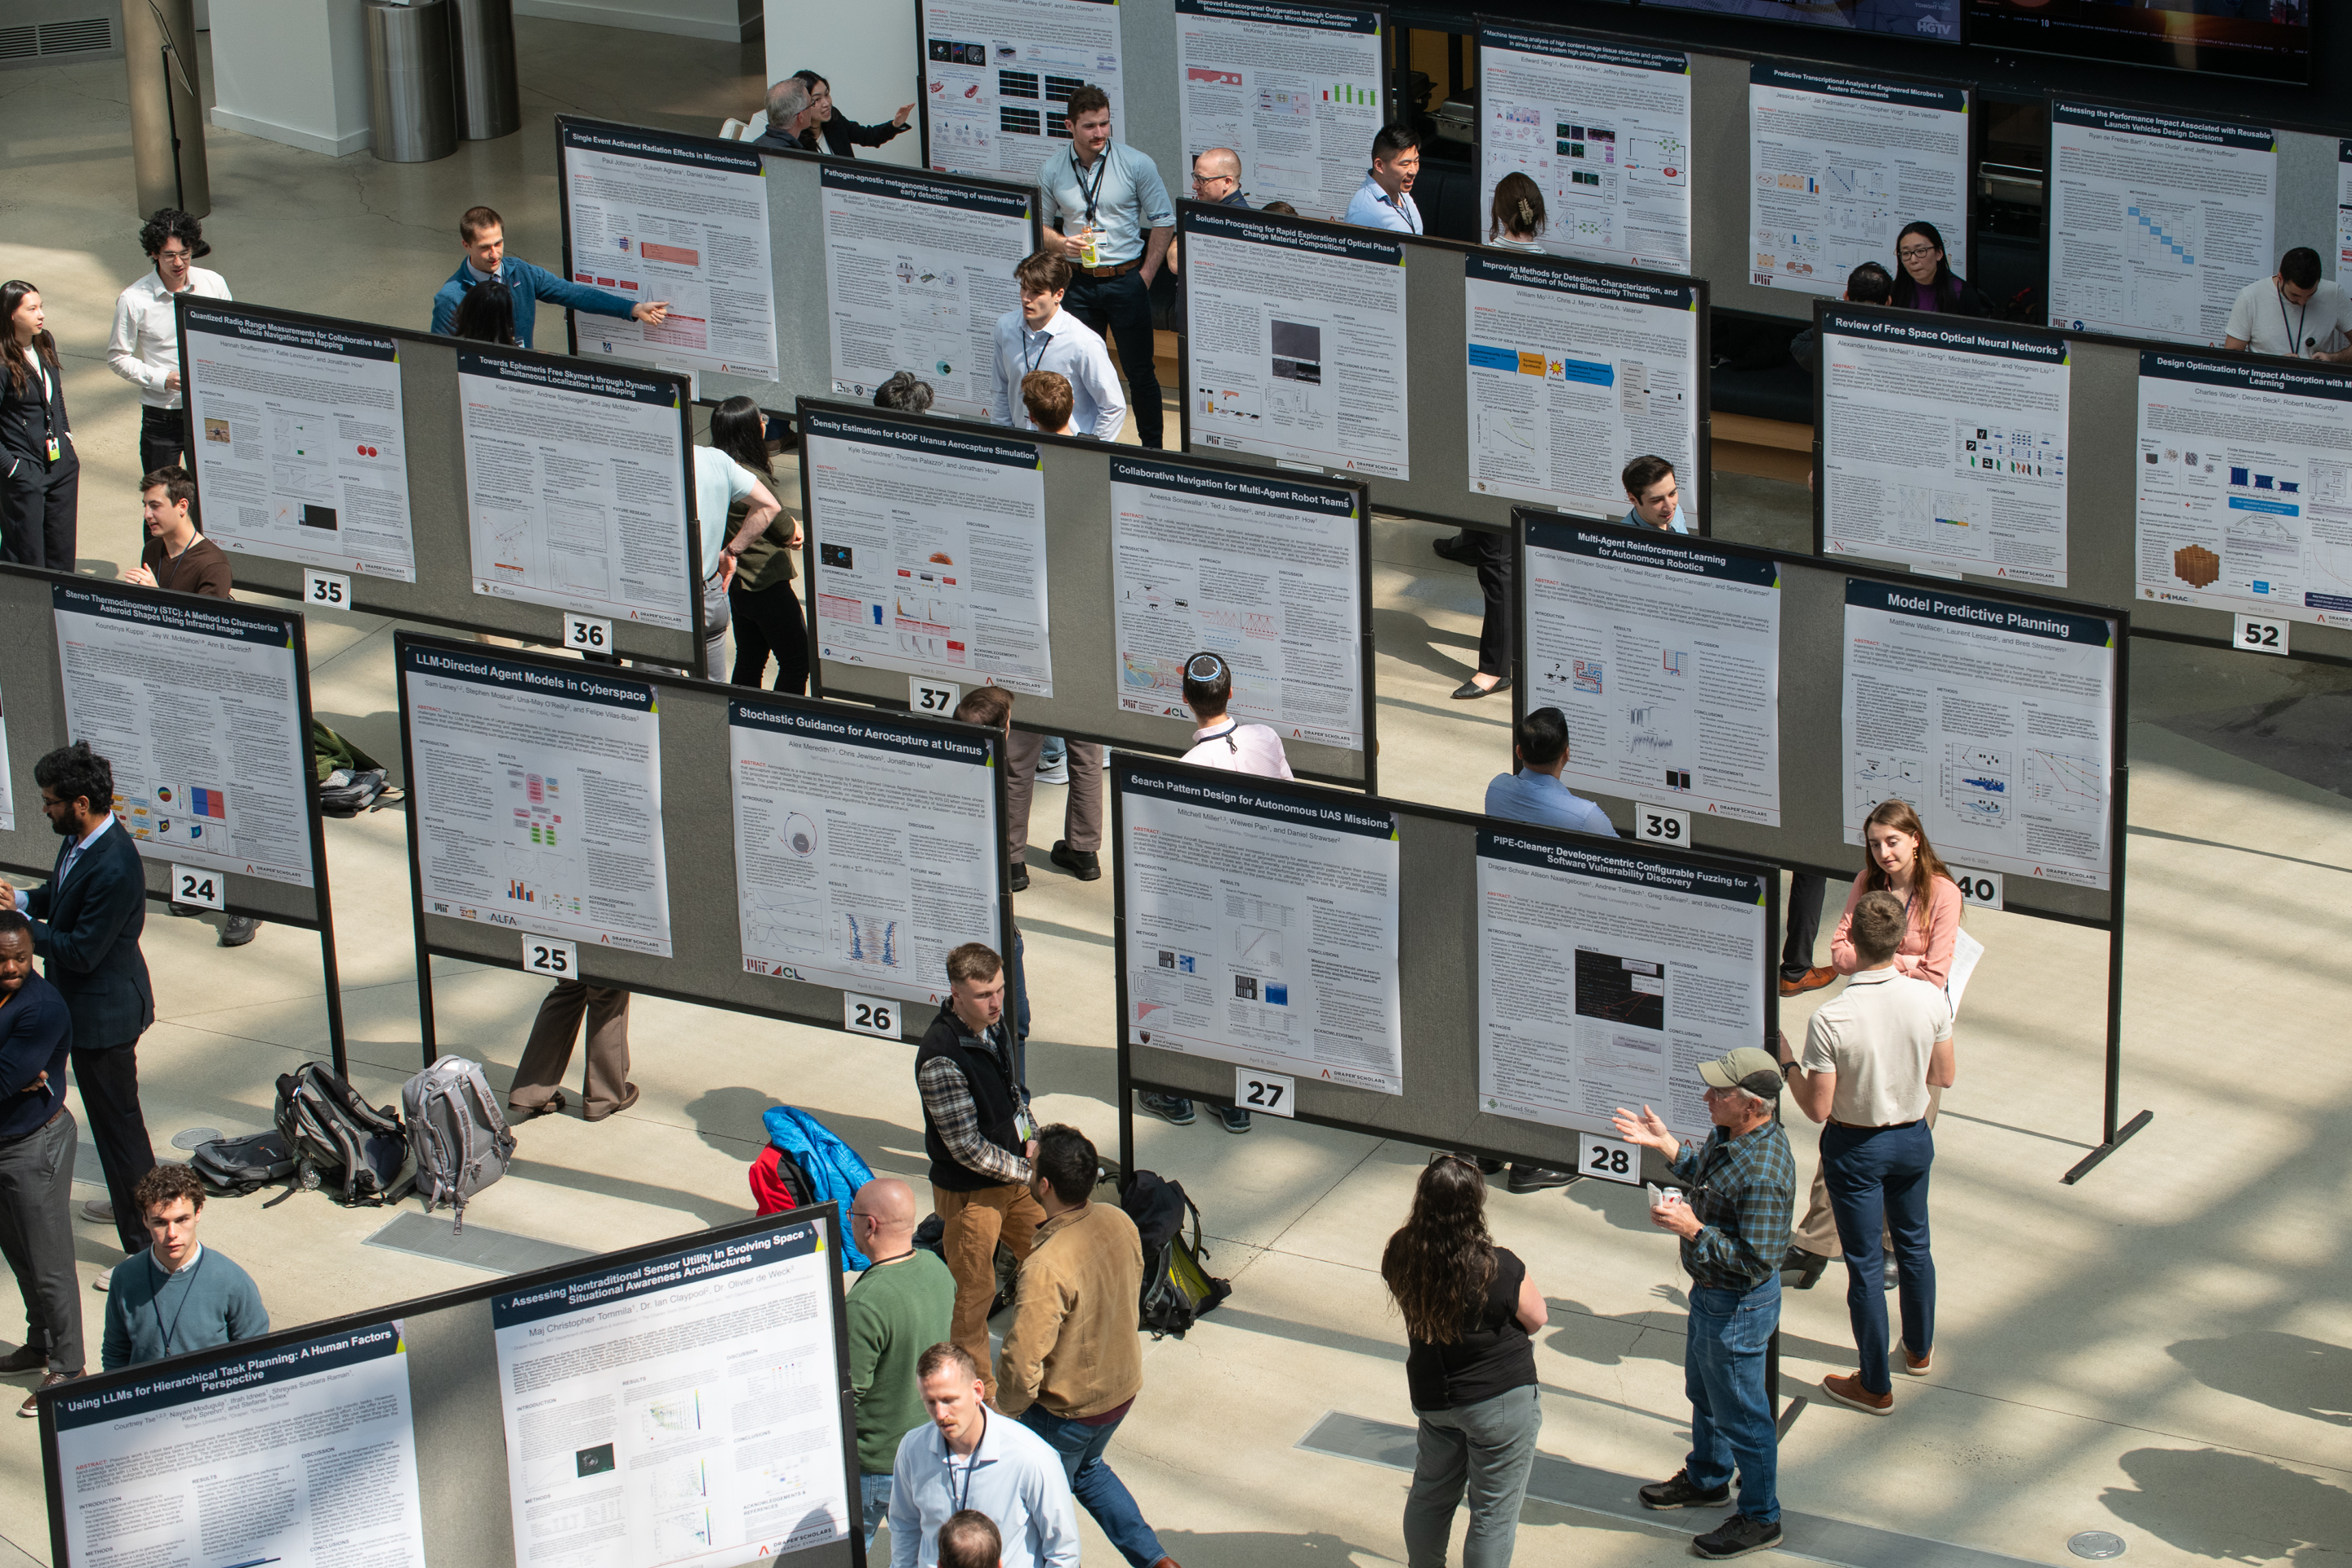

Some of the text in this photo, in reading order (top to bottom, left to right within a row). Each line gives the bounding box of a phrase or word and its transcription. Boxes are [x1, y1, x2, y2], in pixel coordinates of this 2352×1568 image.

[1918, 21, 1951, 34] HGTV
[2060, 105, 2271, 140] Assessing the Performance Impact Associated with Reusable
[2105, 119, 2223, 142] Launch Vehicles Design Decisions
[572, 132, 756, 167] Single Event Activated Radiation Effects in Microelectronics
[1483, 260, 1678, 296] Improving Methods for Detection, Characterization, and
[1510, 272, 1650, 300] Attribution of Novel Biosecurity Threats
[1836, 318, 2058, 355] Review of Free Space Optical Neural Networks
[479, 356, 656, 391] Towards Ephemeris Free Skymark through Dynamic
[500, 367, 635, 398] Simultaneous Localization and Mapping
[813, 418, 1035, 460] Density Estimation for 6-DOF Uranus Aerocapture Simulation
[1118, 465, 1348, 508] Collaborative Navigation for Multi-Agent Robot Teams
[1578, 534, 1726, 566] Multi-Agent Reinforcement Learning
[1598, 547, 1704, 570] for Autonomous Robotics
[314, 580, 341, 602] 35
[1888, 594, 2069, 637] Model Predictive Planning
[574, 622, 603, 645] 36
[2245, 623, 2278, 647] 52
[416, 655, 645, 702] LLM-Directed Agent Models in Cyberspace
[920, 688, 950, 710] 37
[739, 708, 982, 755] Stochastic Guidance for Aerocapture at Uranus
[1131, 776, 1388, 827] Search Pattern Design for Autonomous UAS Missions
[1646, 814, 1680, 839] 39
[1494, 837, 1748, 887] PIPE-Cleaner: Developer-centric Configurable Fuzzing for
[1547, 855, 1691, 889] Software Vulnerability Discovery
[182, 875, 215, 901] 24
[1956, 876, 1994, 901] 40
[490, 913, 517, 926] ALFA
[534, 947, 567, 971] 25
[856, 1004, 890, 1030] 26
[1248, 1081, 1283, 1107] 27
[1499, 1102, 1522, 1111] Portland
[1591, 1146, 1628, 1174] 28
[512, 1232, 804, 1306] Assessing Nontraditional Sensor Utility in Evolving Space
[568, 1255, 752, 1304] Situational Awareness Architectures
[529, 1325, 546, 1337] Maj
[546, 1314, 596, 1333] Christopher
[640, 1300, 652, 1311] Dr.
[655, 1298, 666, 1307] Ian
[715, 1283, 725, 1293] Dr.
[729, 1276, 753, 1290] Olivier
[757, 1272, 765, 1282] de
[69, 1332, 390, 1411] Using LLMs for Hierarchical Task Planning: A Human Factors
[202, 1370, 264, 1392] Perspective
[302, 1447, 335, 1459] DISCUSSION
[192, 1475, 217, 1484] RESULTS
[79, 1496, 122, 1509] INTRODUCTION
[86, 1547, 114, 1557] METHODS
